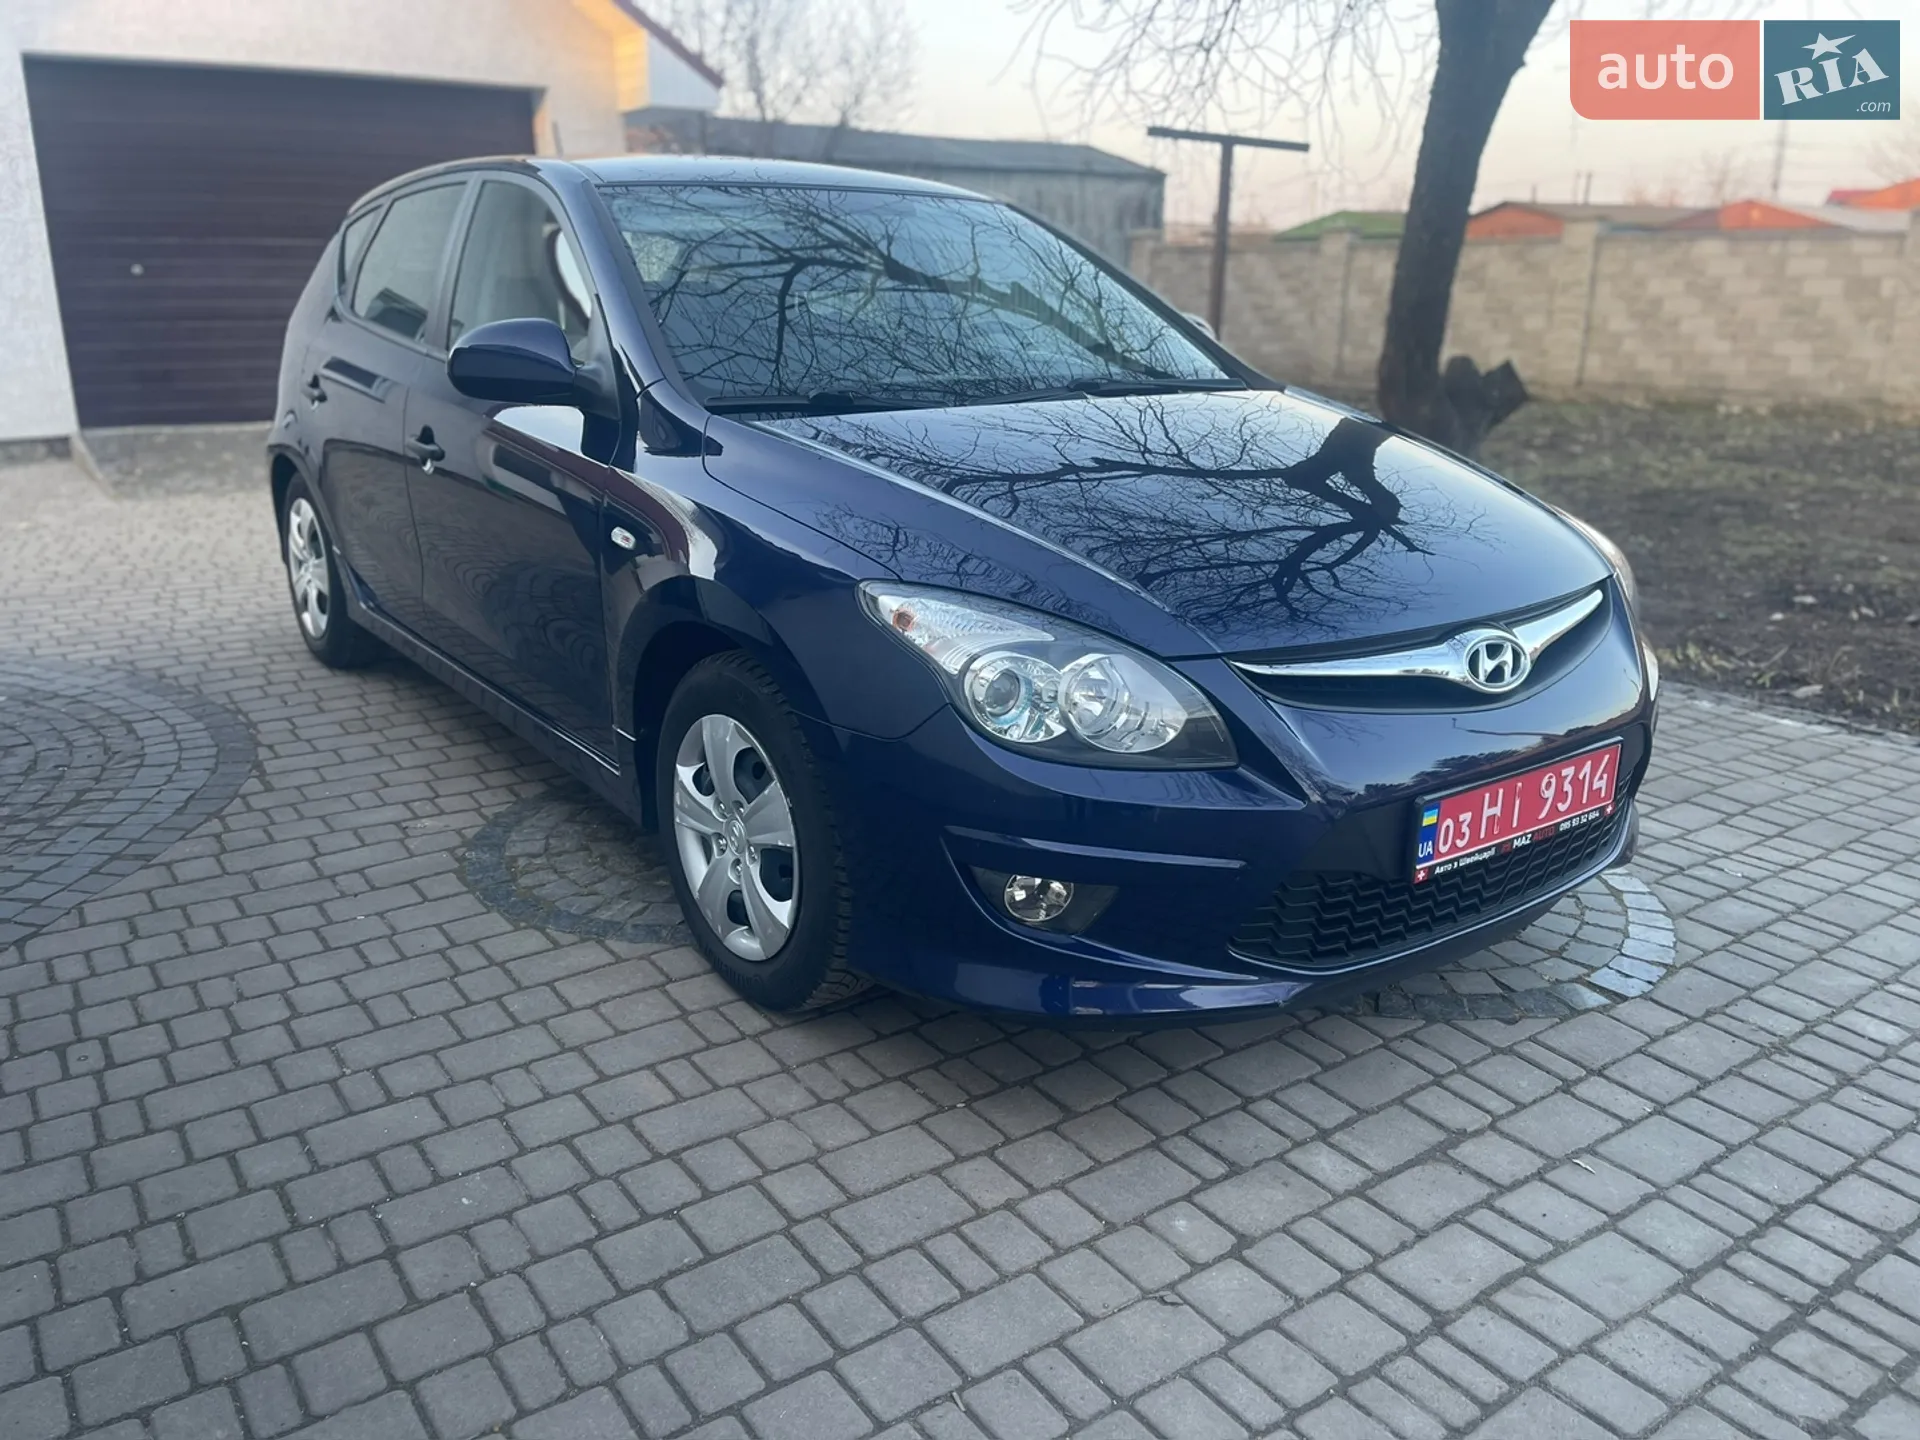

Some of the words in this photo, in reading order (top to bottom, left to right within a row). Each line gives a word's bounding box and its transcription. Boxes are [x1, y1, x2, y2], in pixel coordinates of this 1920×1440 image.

[1438, 811, 1472, 854] 03
[1538, 754, 1611, 820] 9314
[1418, 841, 1433, 858] UA
[1513, 834, 1532, 849] MAZ
[1434, 863, 1452, 875] Авто
